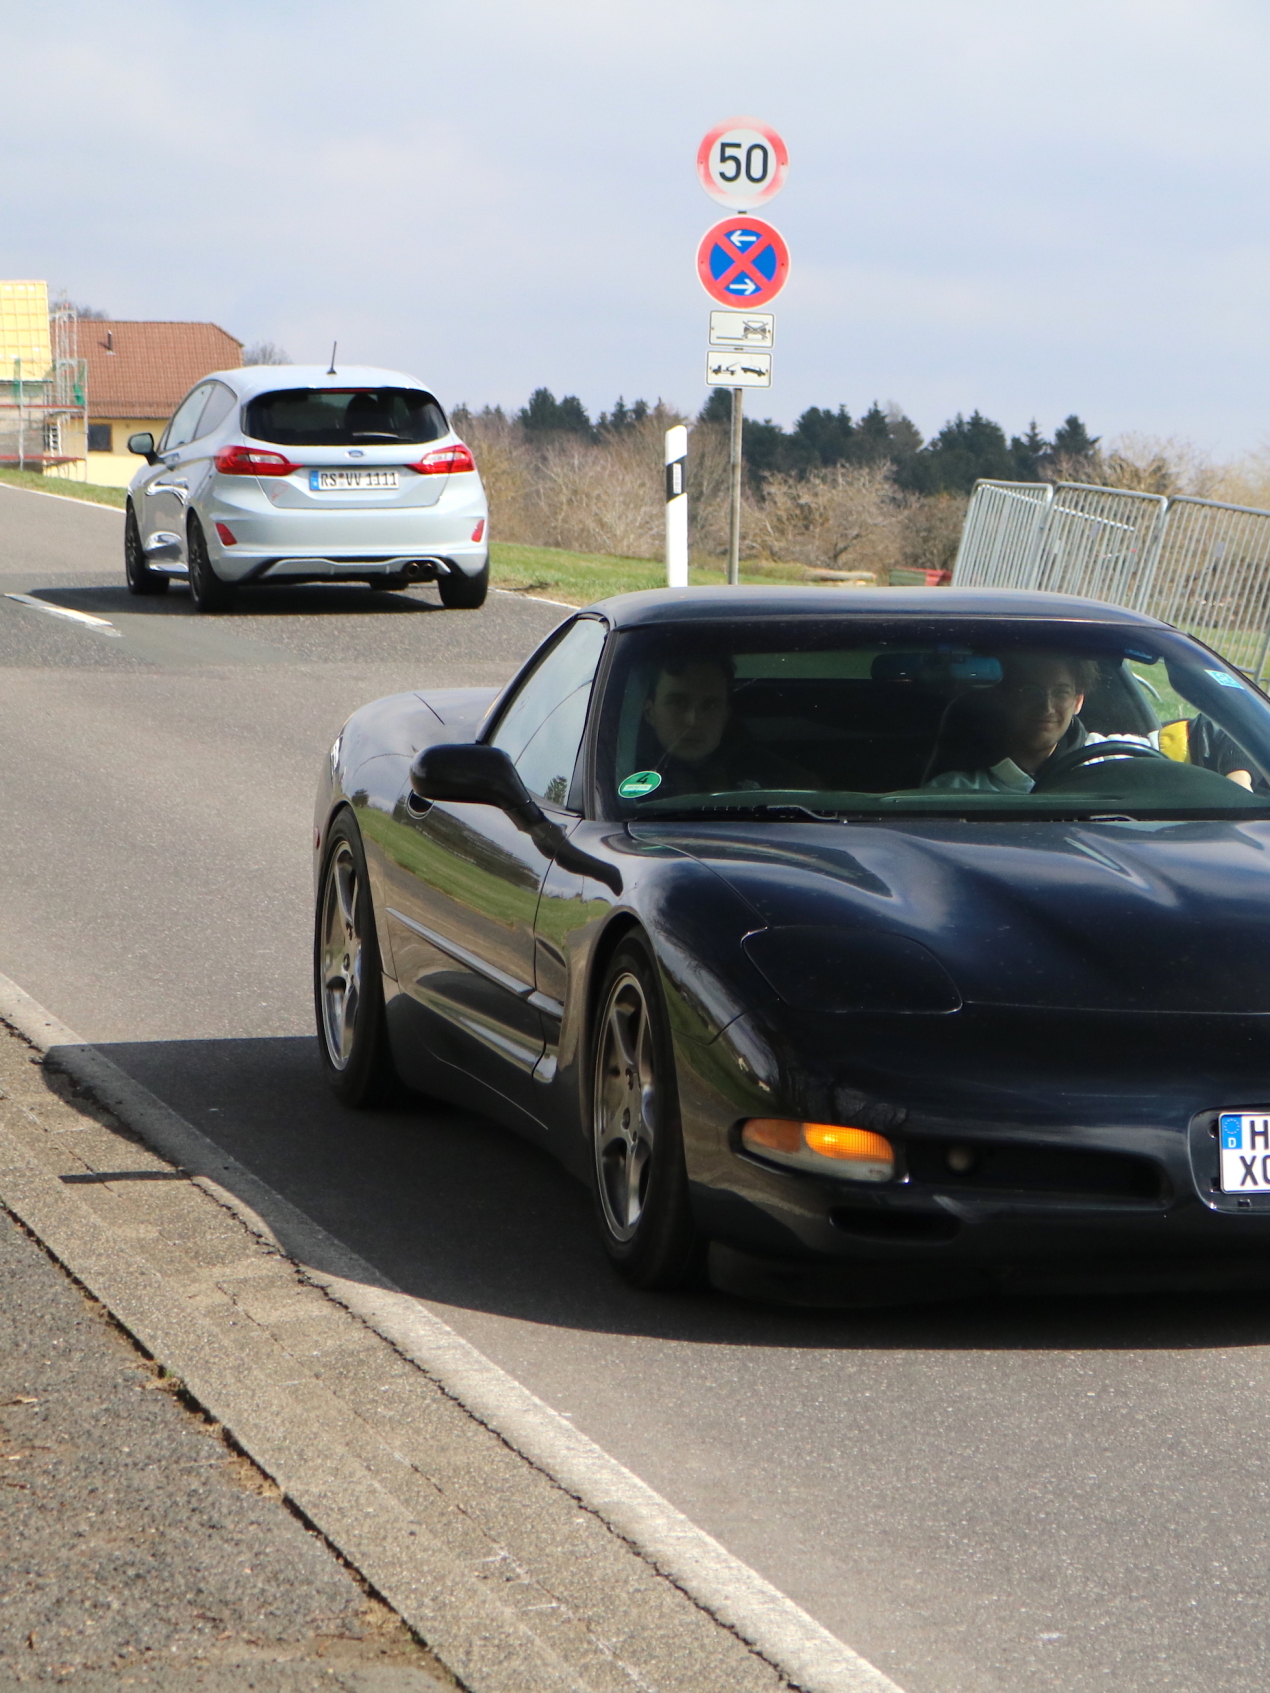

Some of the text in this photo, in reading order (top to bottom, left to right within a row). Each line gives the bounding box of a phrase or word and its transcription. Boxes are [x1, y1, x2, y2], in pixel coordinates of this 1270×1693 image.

[719, 142, 769, 183] 50
[320, 472, 337, 487] RS
[366, 471, 397, 486] 1111
[636, 772, 650, 785] 4
[1228, 1137, 1237, 1148] D
